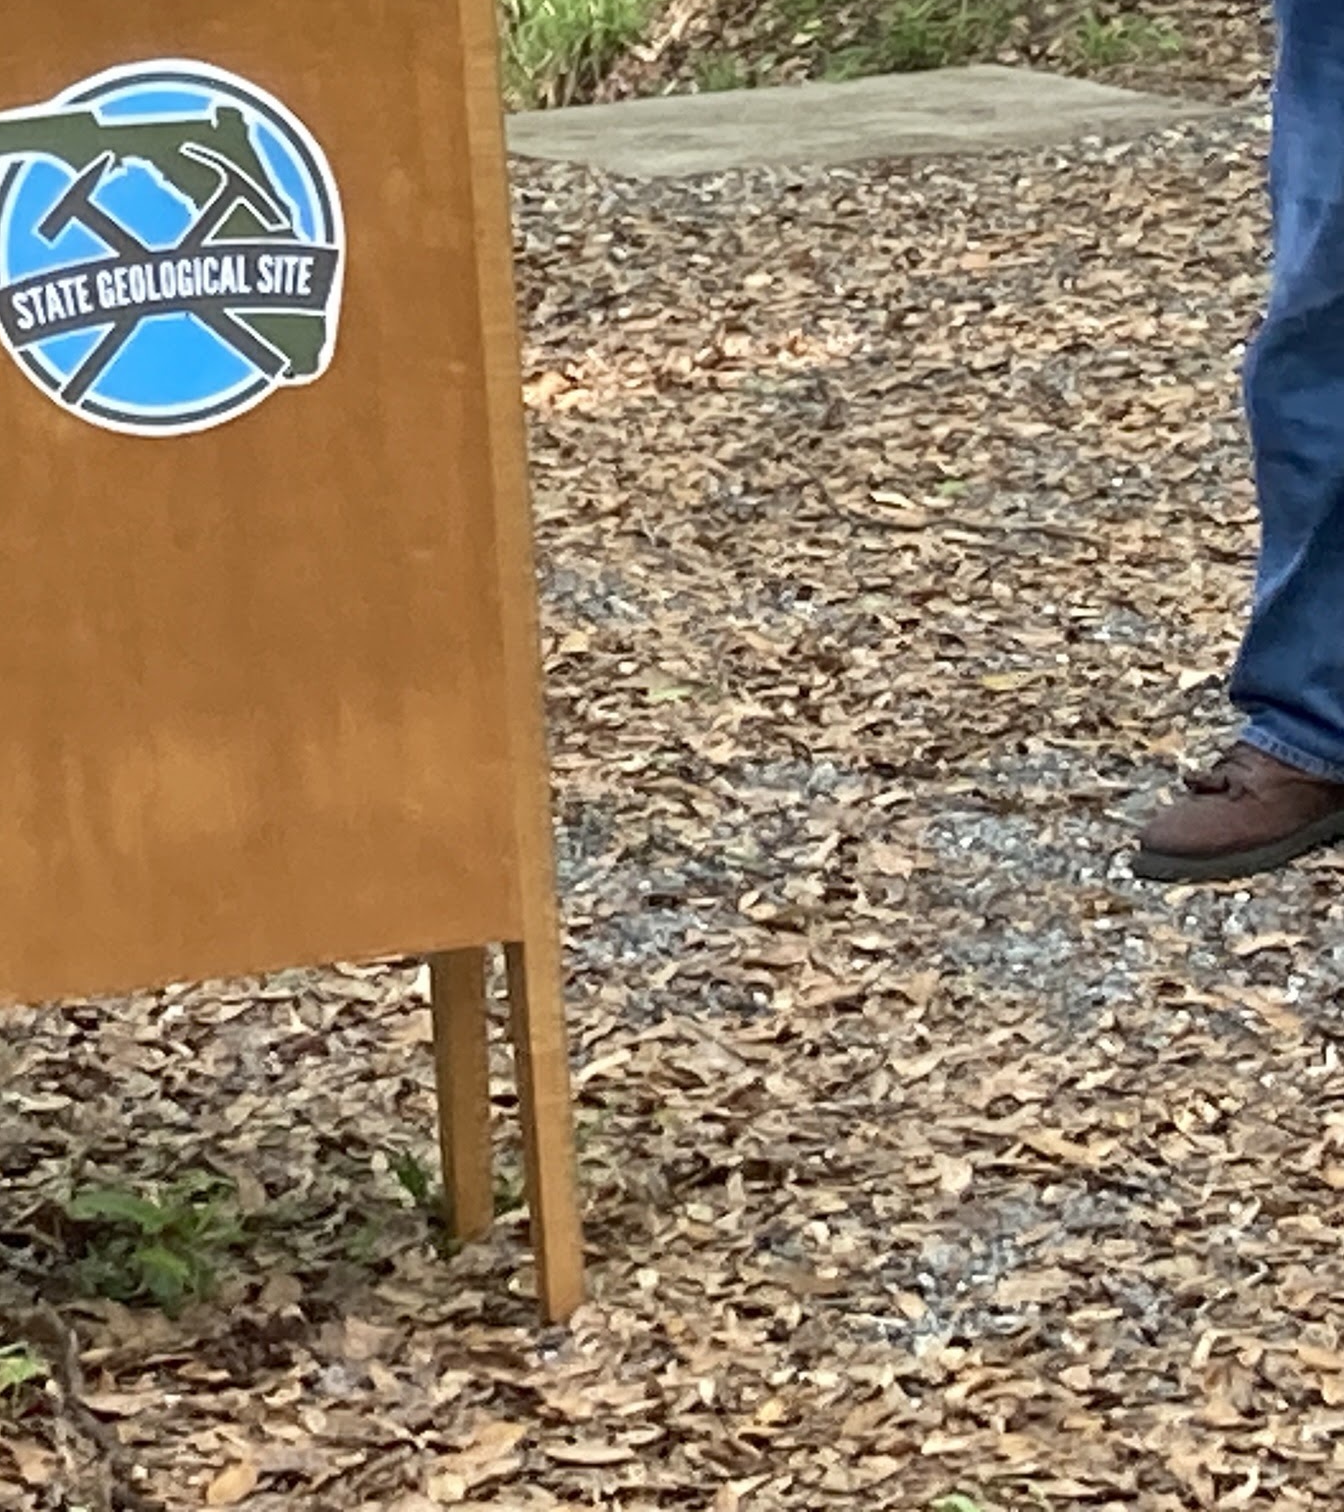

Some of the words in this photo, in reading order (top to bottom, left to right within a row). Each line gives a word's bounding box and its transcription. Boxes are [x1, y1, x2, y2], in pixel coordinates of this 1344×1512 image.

[11, 273, 94, 330] STATE
[95, 255, 251, 308] GEOLOGICAL
[256, 253, 314, 296] SITE
